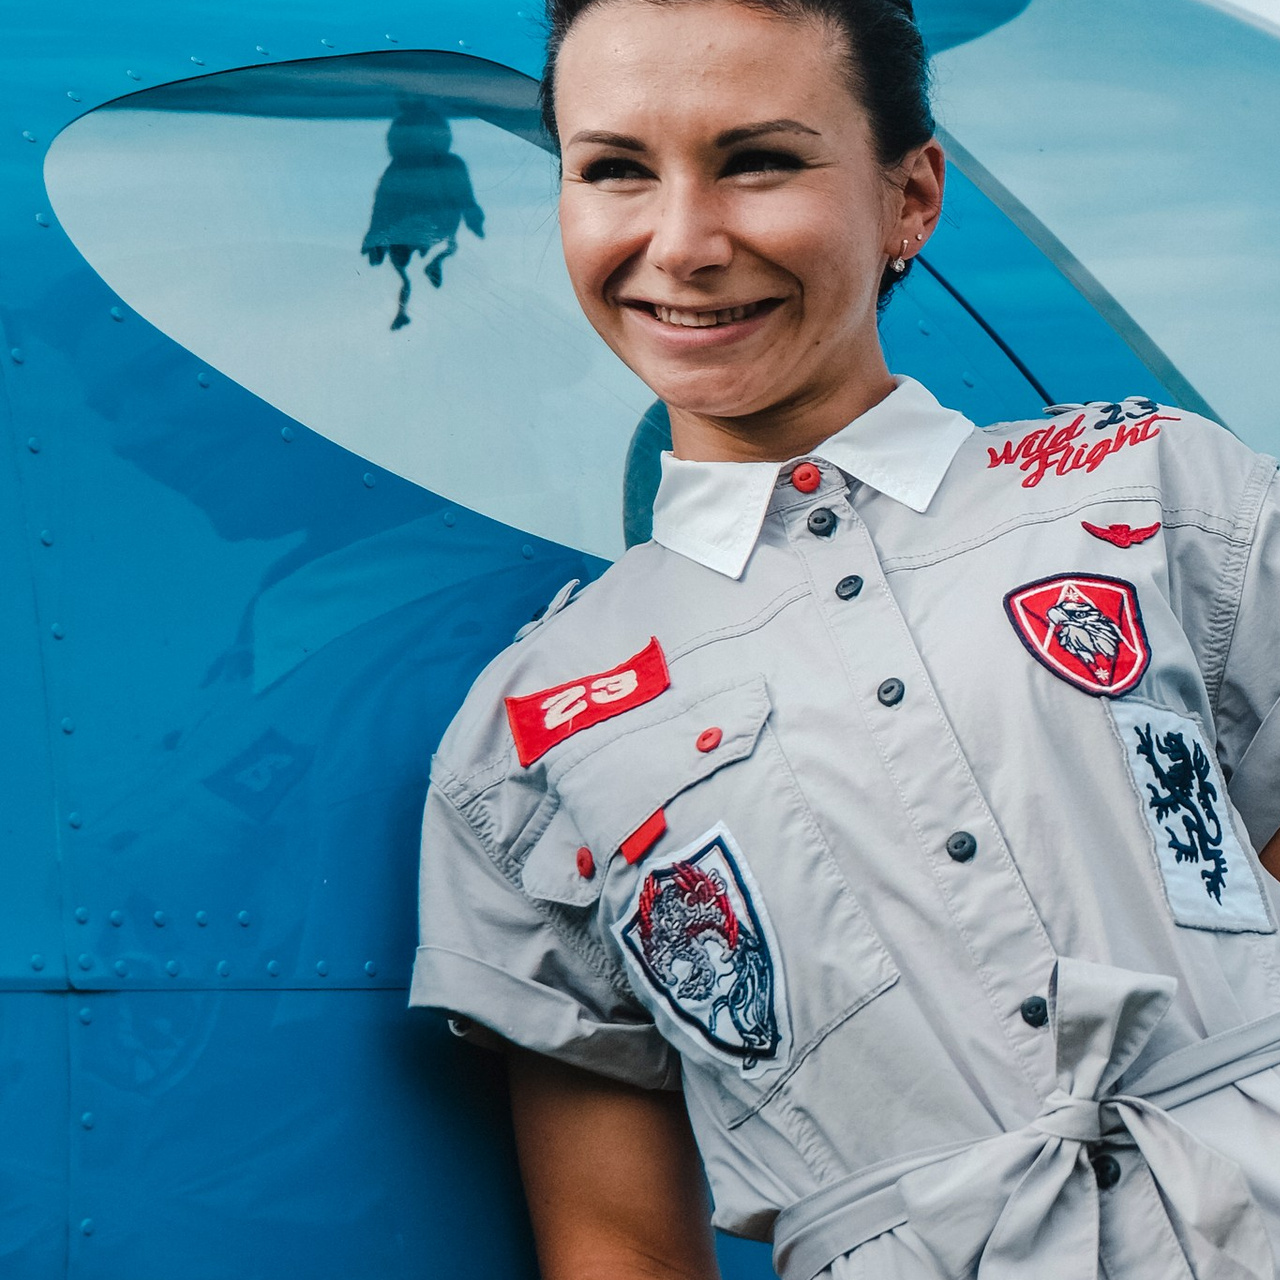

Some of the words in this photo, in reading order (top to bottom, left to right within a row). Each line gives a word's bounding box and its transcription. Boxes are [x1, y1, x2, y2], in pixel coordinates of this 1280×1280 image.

[987, 413, 1086, 469] Wild
[1094, 399, 1160, 430] 23
[1020, 413, 1182, 489] Flight
[540, 669, 639, 730] 23
